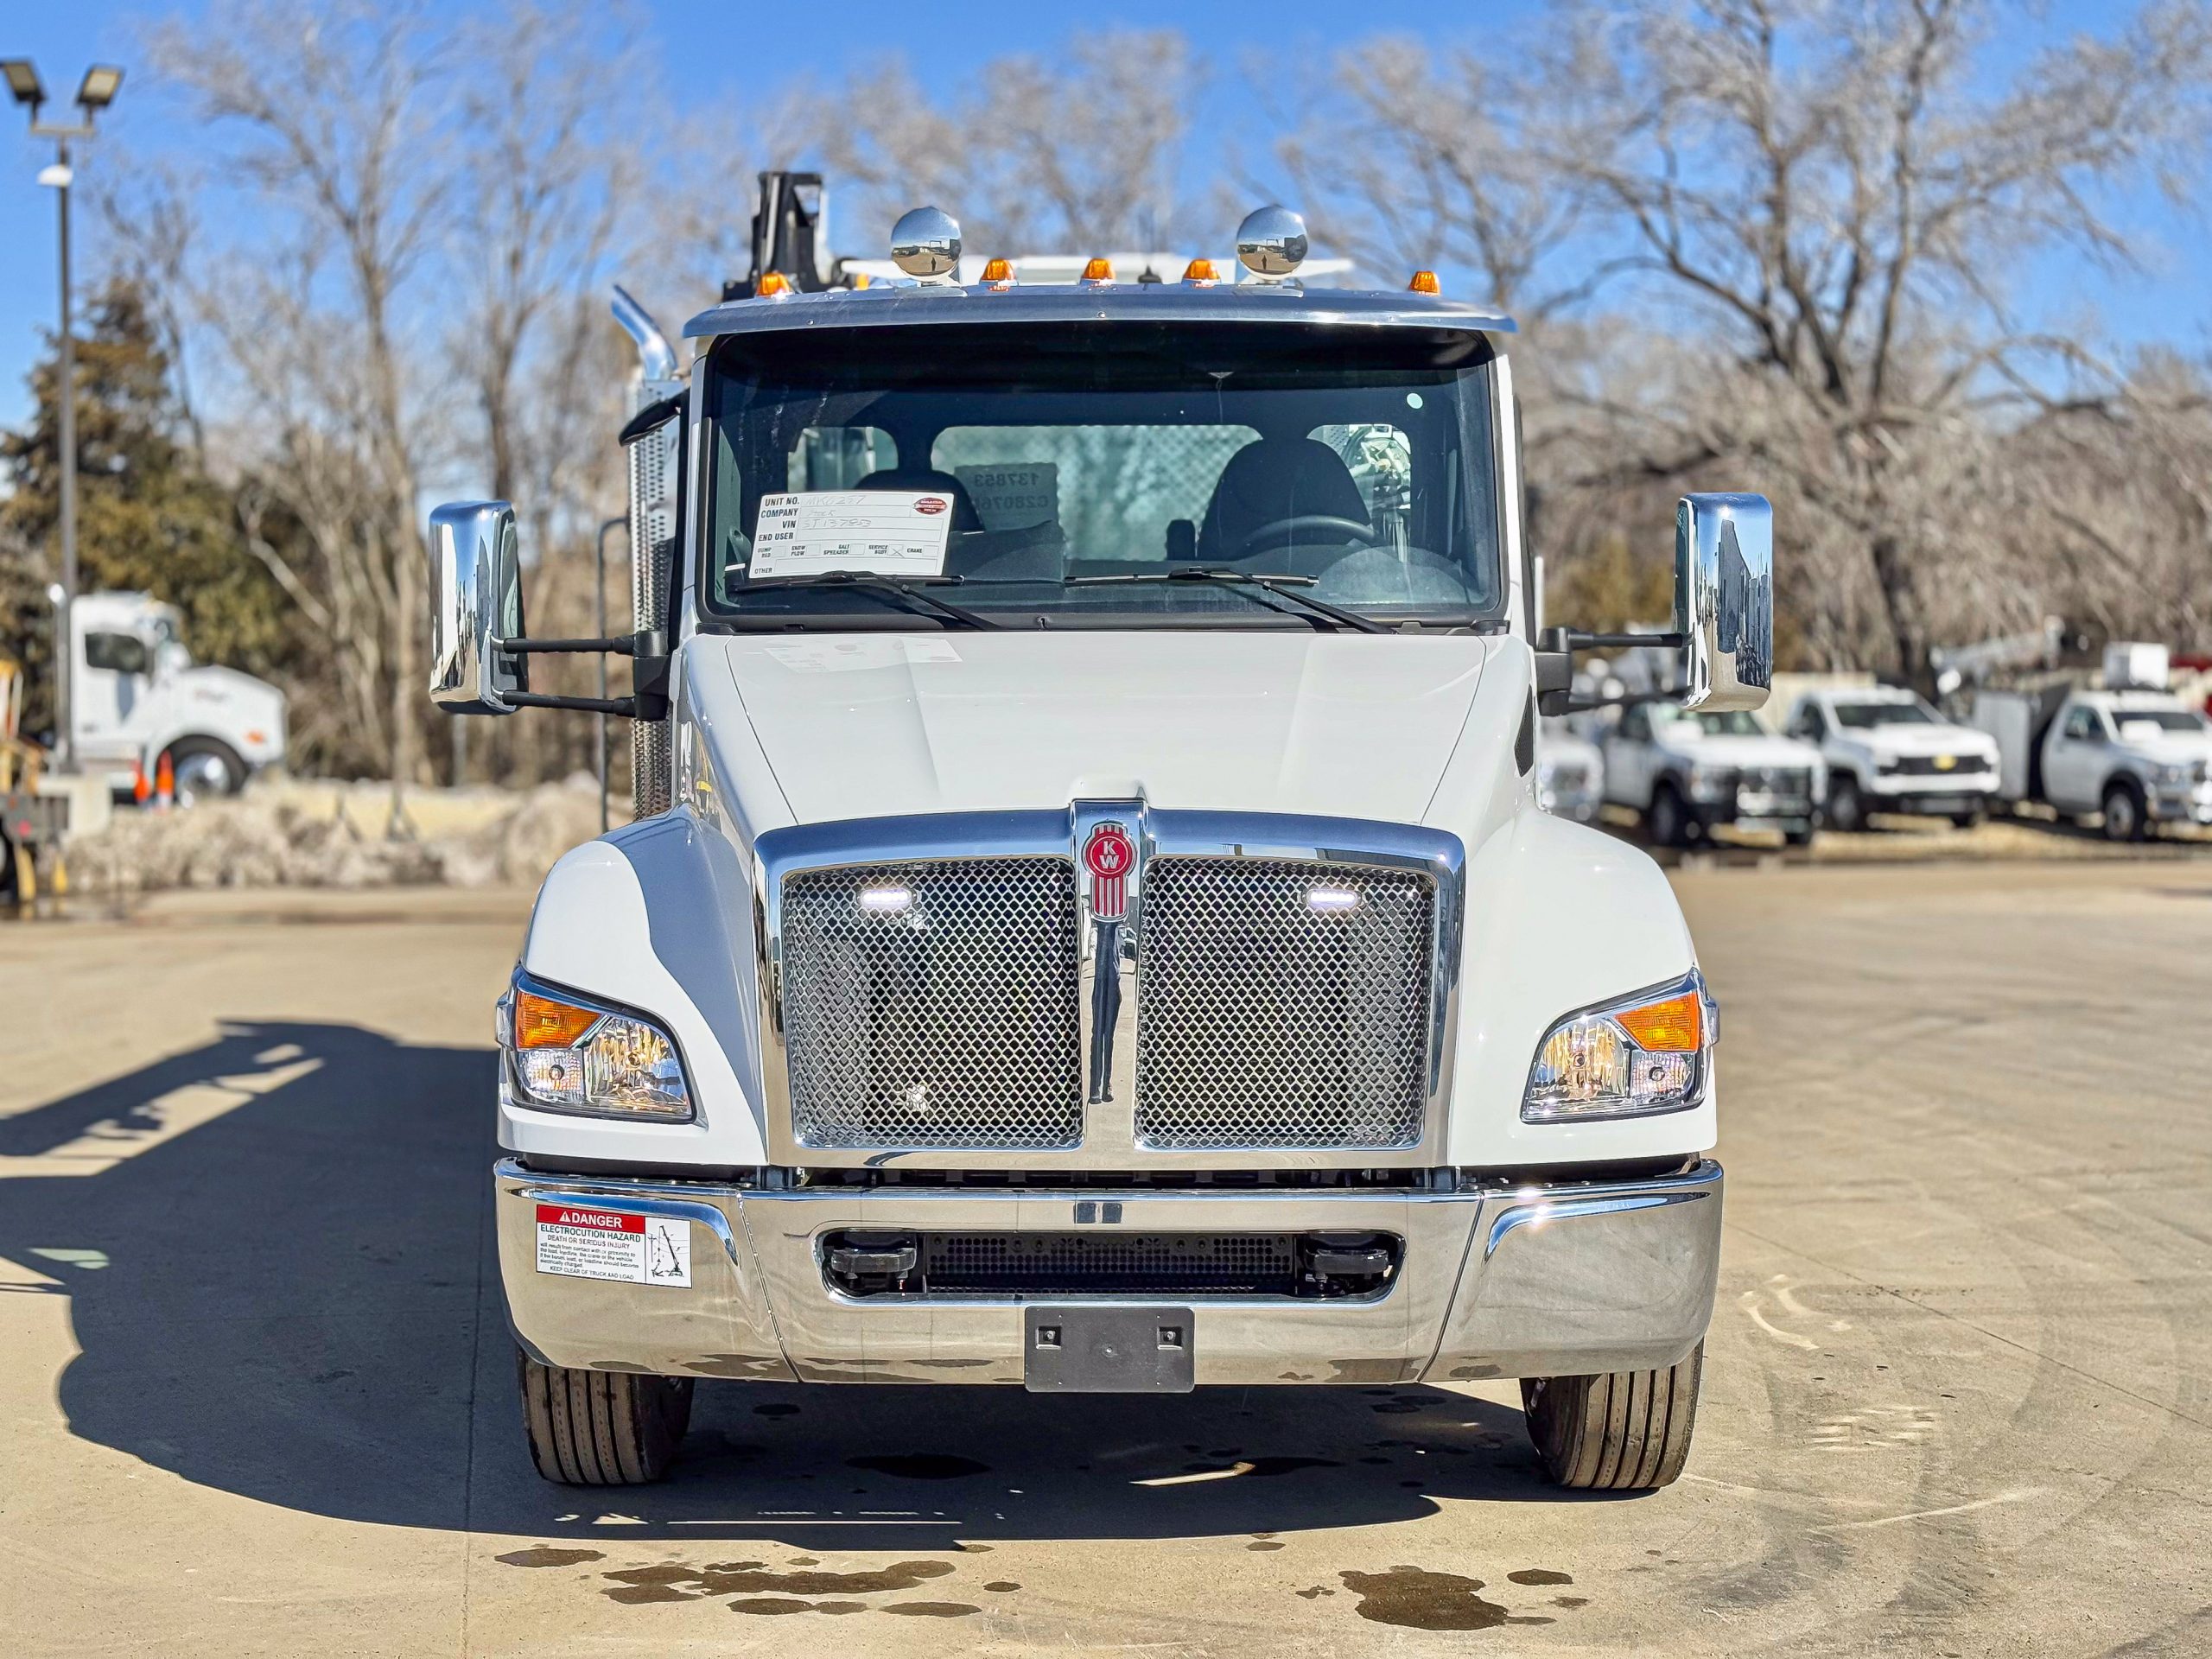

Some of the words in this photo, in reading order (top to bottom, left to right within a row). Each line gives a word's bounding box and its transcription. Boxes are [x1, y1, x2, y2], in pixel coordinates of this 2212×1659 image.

[765, 497, 784, 507] UNIT
[785, 496, 800, 505] NO.
[760, 508, 798, 518] COMPANY
[782, 520, 796, 529] VIN
[759, 533, 772, 542] END
[774, 532, 793, 541] USER
[571, 1211, 623, 1229] DANGER
[540, 1224, 606, 1239] ELECTROCUTION
[607, 1231, 641, 1243] HAZARD
[547, 1234, 568, 1243] DEATH
[578, 1238, 607, 1247] SERIOUS
[607, 1241, 631, 1249] INJURY
